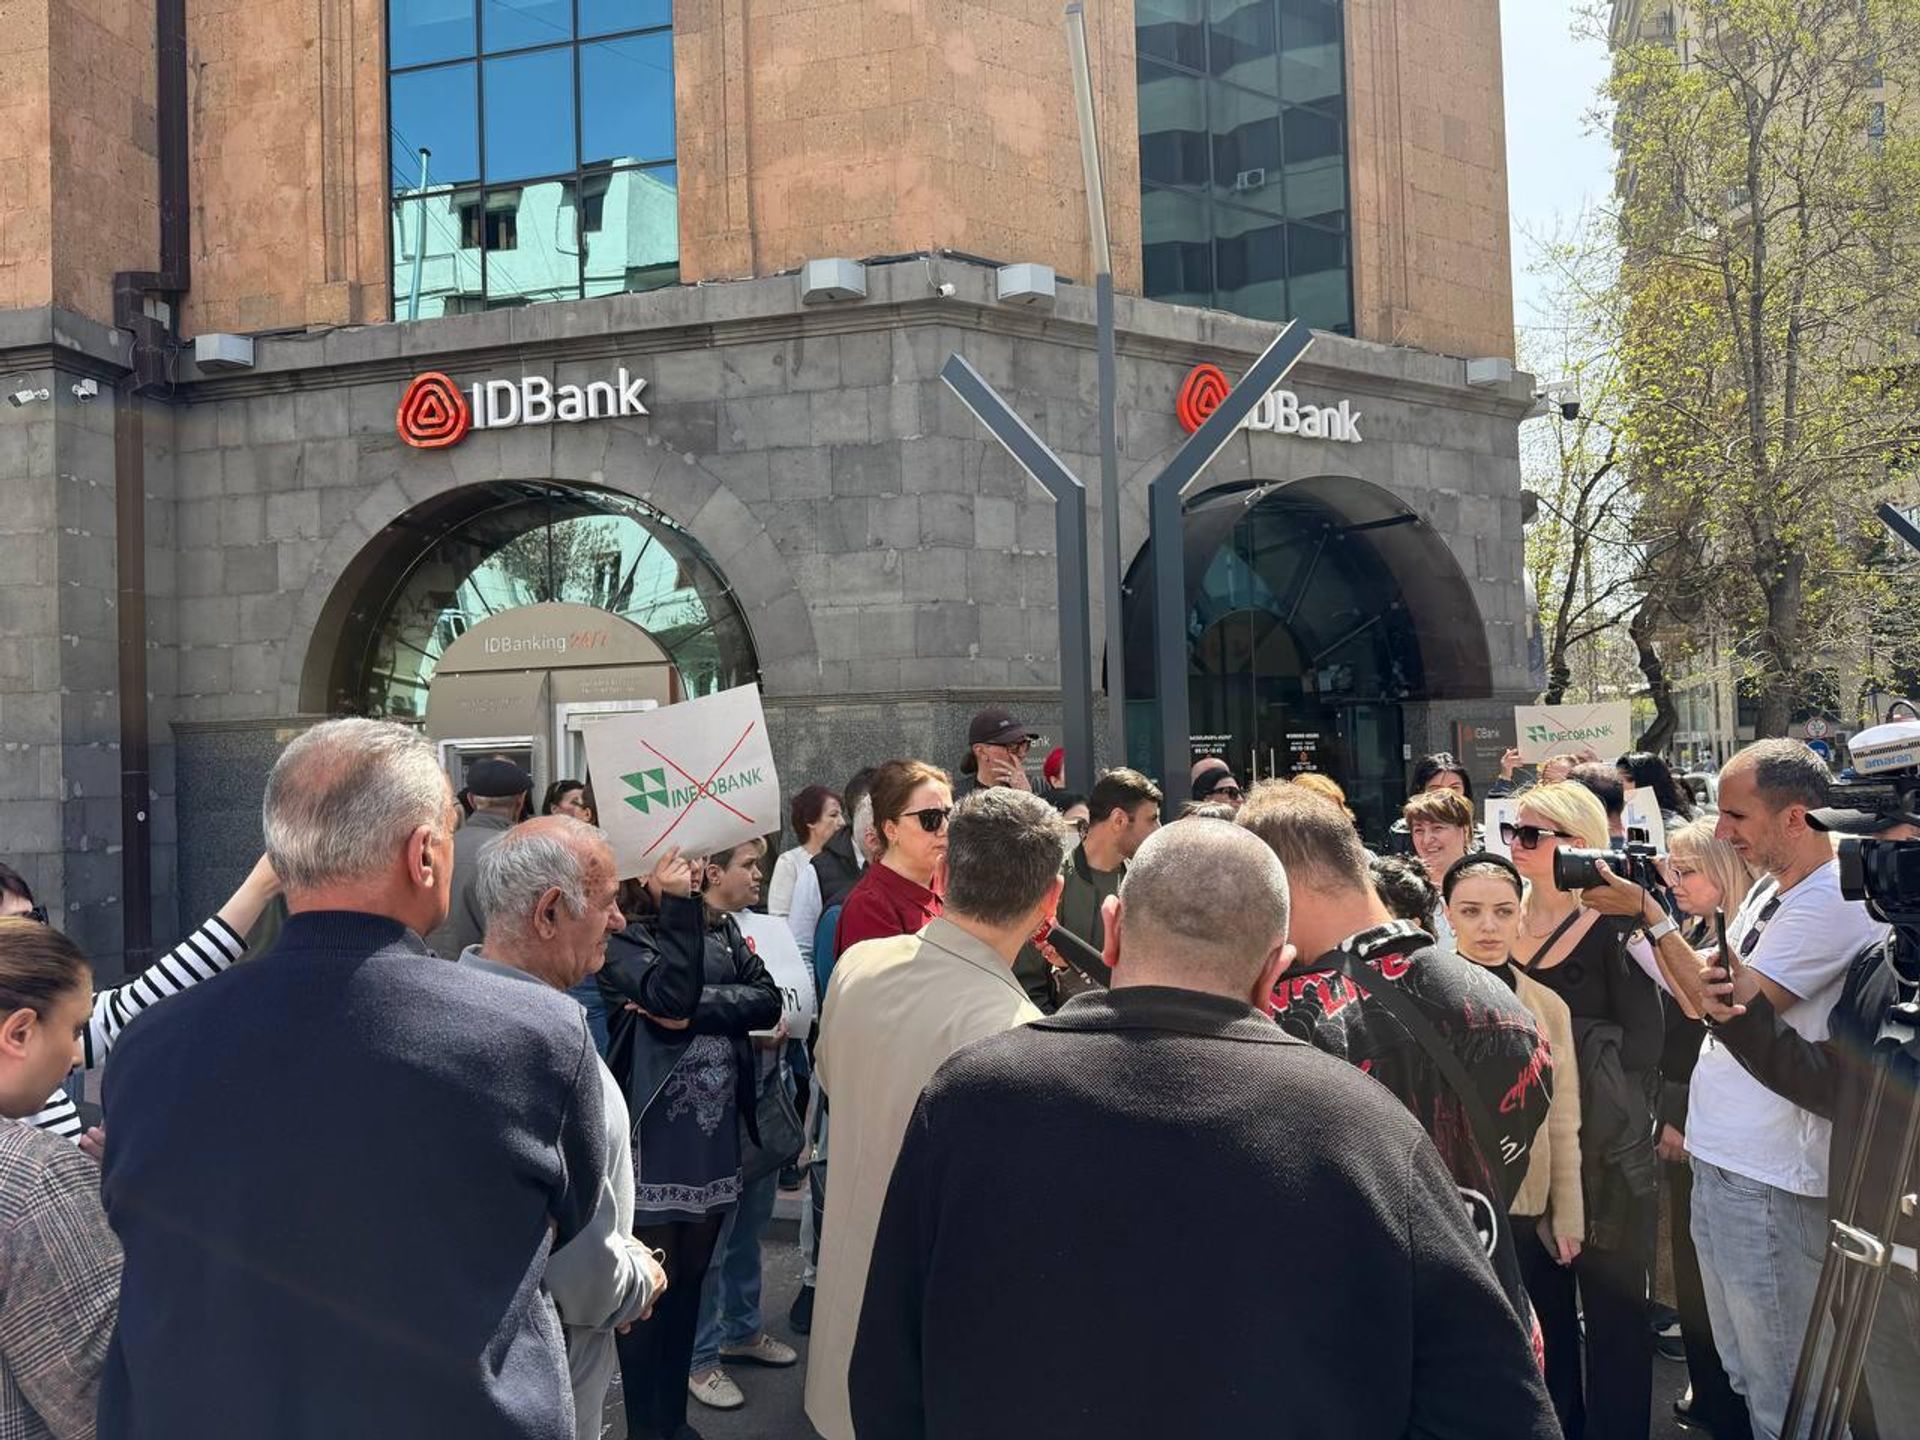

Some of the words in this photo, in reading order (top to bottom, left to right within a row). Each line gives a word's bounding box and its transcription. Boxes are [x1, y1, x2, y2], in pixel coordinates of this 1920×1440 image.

[472, 368, 649, 429] IDBank
[1240, 389, 1363, 443] DBank
[484, 635, 566, 654] IDBanking
[1865, 753, 1913, 769] amaran
